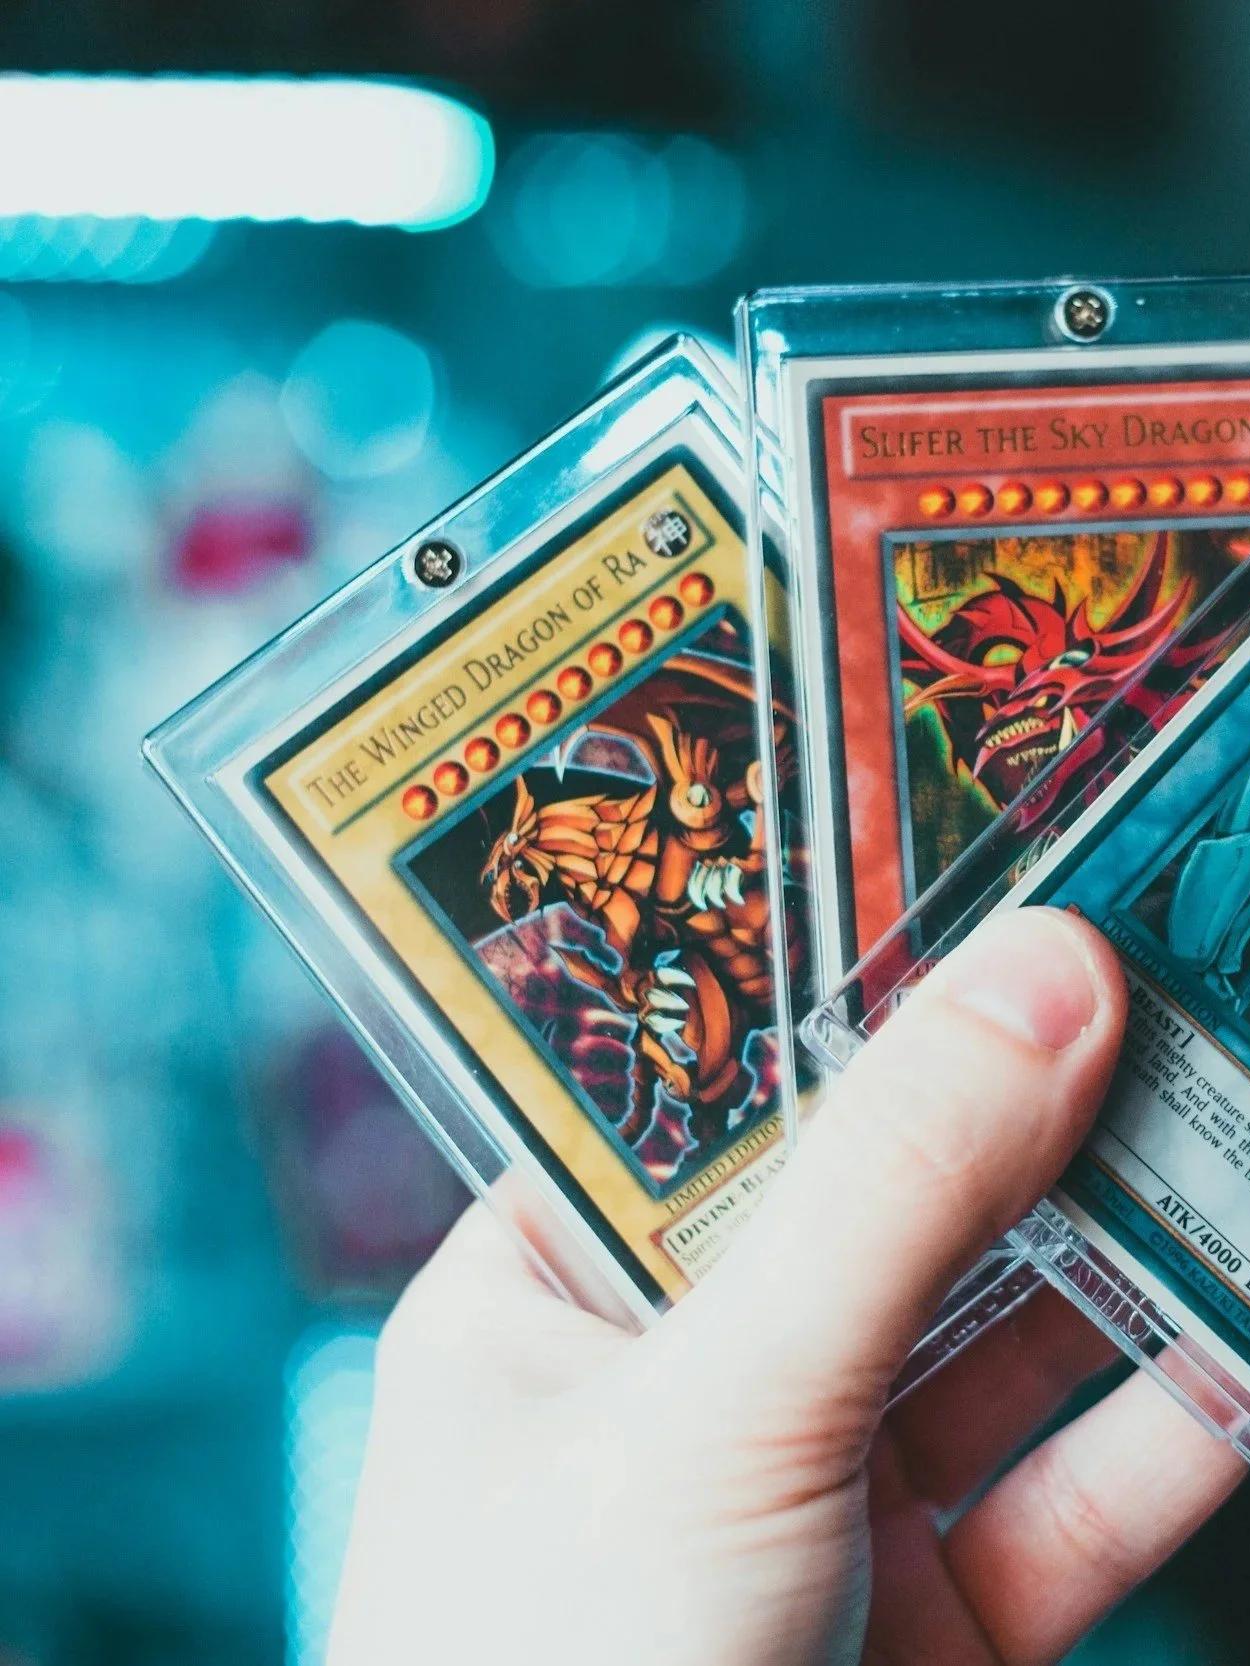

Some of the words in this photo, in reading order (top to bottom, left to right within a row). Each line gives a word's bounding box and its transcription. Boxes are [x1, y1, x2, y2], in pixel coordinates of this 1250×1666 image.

[860, 426, 963, 458] SLIFER
[977, 425, 1037, 451] THE
[1049, 418, 1110, 451] SKY
[304, 751, 369, 812] THE
[359, 675, 470, 770] WINGED
[461, 595, 574, 692] DRAGON
[1147, 1052, 1182, 1086] land.
[1180, 1083, 1210, 1112] And
[1207, 1109, 1239, 1139] with
[1153, 1035, 1199, 1080] mighty
[1194, 1074, 1246, 1124] creature
[1157, 1086, 1191, 1119] shall
[1187, 1114, 1224, 1150] know
[1221, 1146, 1246, 1170] the
[663, 1160, 729, 1214] LIMITED
[1154, 1191, 1244, 1275] ATK/4000
[1186, 1266, 1236, 1313] KAZUKI
